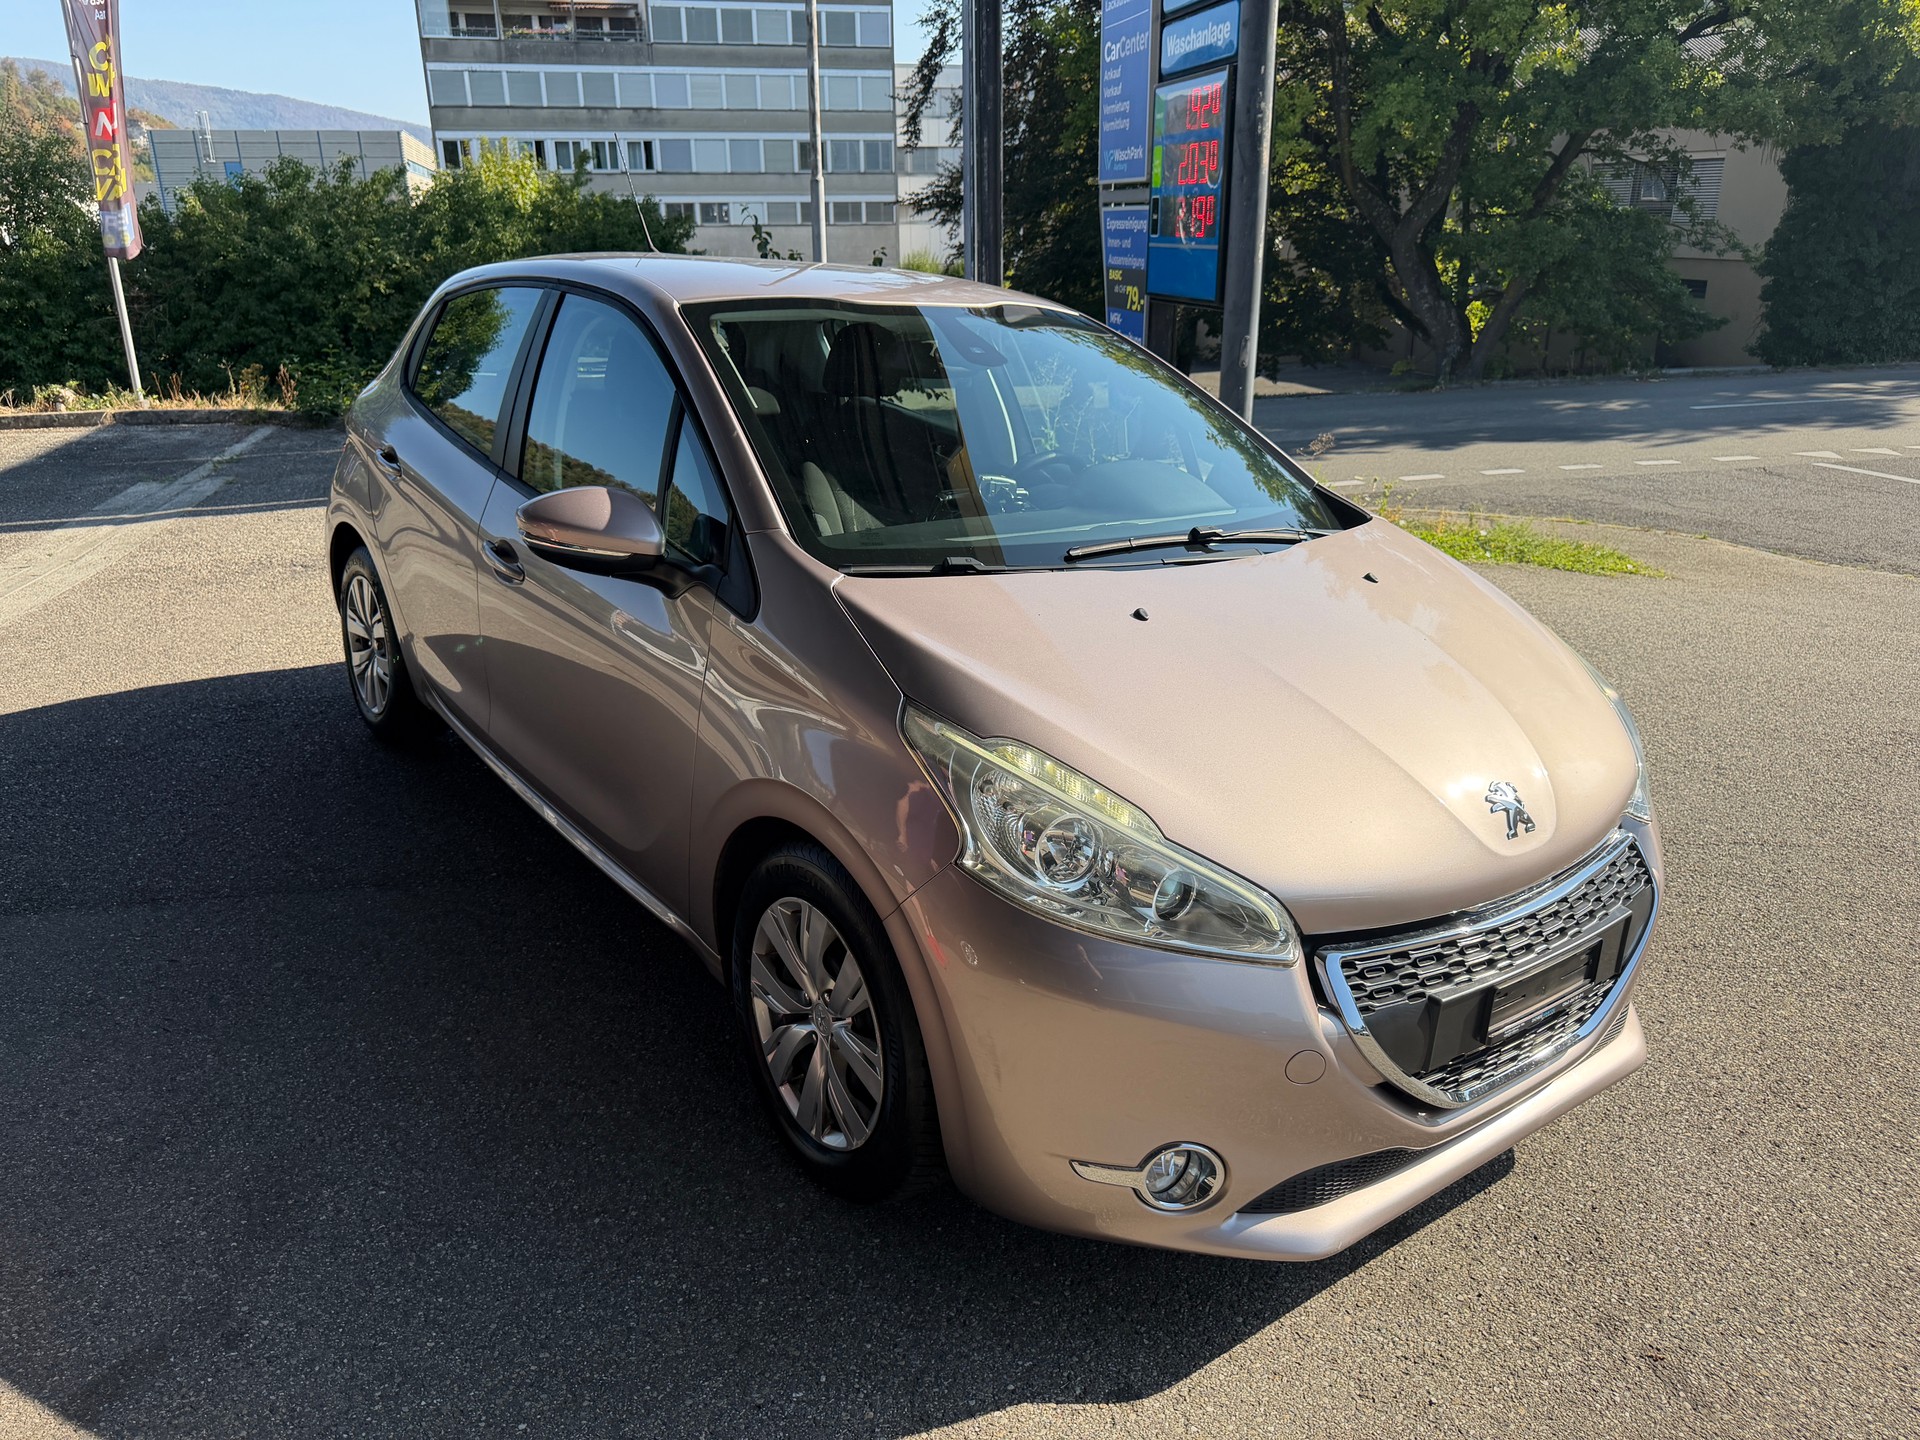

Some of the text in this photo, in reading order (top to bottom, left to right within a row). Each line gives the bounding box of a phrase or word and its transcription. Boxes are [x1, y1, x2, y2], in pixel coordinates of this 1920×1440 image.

[1104, 31, 1149, 63] CarCenter
[1166, 21, 1231, 57] Waschanlage
[1104, 65, 1122, 81] Ankauf
[1103, 82, 1122, 98] Verkauf
[1102, 100, 1130, 115] Vermietung
[1102, 118, 1130, 132] Vermittlung
[1114, 145, 1143, 162] WaschPark
[1106, 216, 1147, 232] Expressreinigung
[1107, 236, 1131, 248] Innen- und
[1108, 254, 1145, 270] Aussenreinigung
[1108, 269, 1123, 281] BASIC
